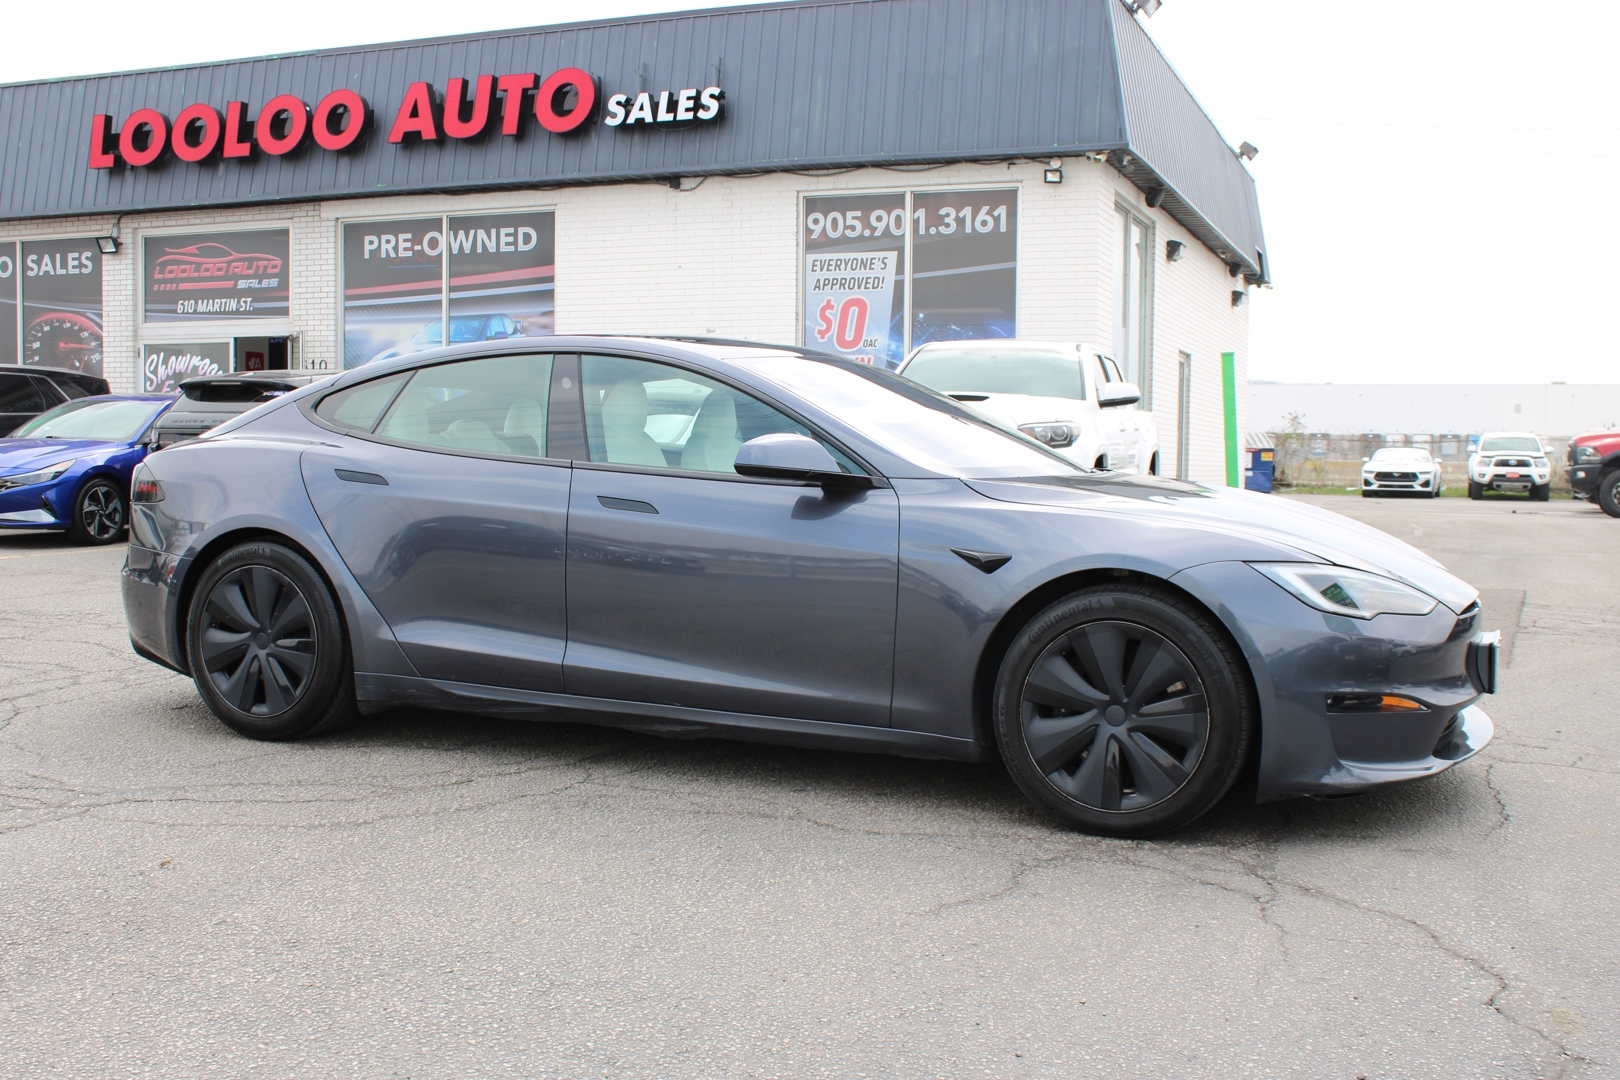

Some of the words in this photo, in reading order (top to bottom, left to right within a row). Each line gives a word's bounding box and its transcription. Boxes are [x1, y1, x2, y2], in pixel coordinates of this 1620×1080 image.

[89, 89, 367, 169] LOOLOO
[387, 67, 596, 144] AUTO
[604, 86, 723, 127] SALES
[807, 205, 1007, 239] 905.901.3161
[364, 226, 538, 259] PRE-OWNED
[26, 251, 93, 277] SALES
[153, 263, 228, 279] LOOLOO
[228, 260, 283, 276] AUTO
[811, 256, 889, 273] EVERYONE'S
[237, 278, 280, 289] SALES
[812, 276, 886, 291] APPROVED!
[177, 300, 196, 314] 610
[197, 298, 238, 313] MARTIN
[239, 297, 254, 311] ST.
[817, 297, 869, 350] $0
[862, 339, 879, 348] OAC
[145, 352, 224, 391] Showroo
